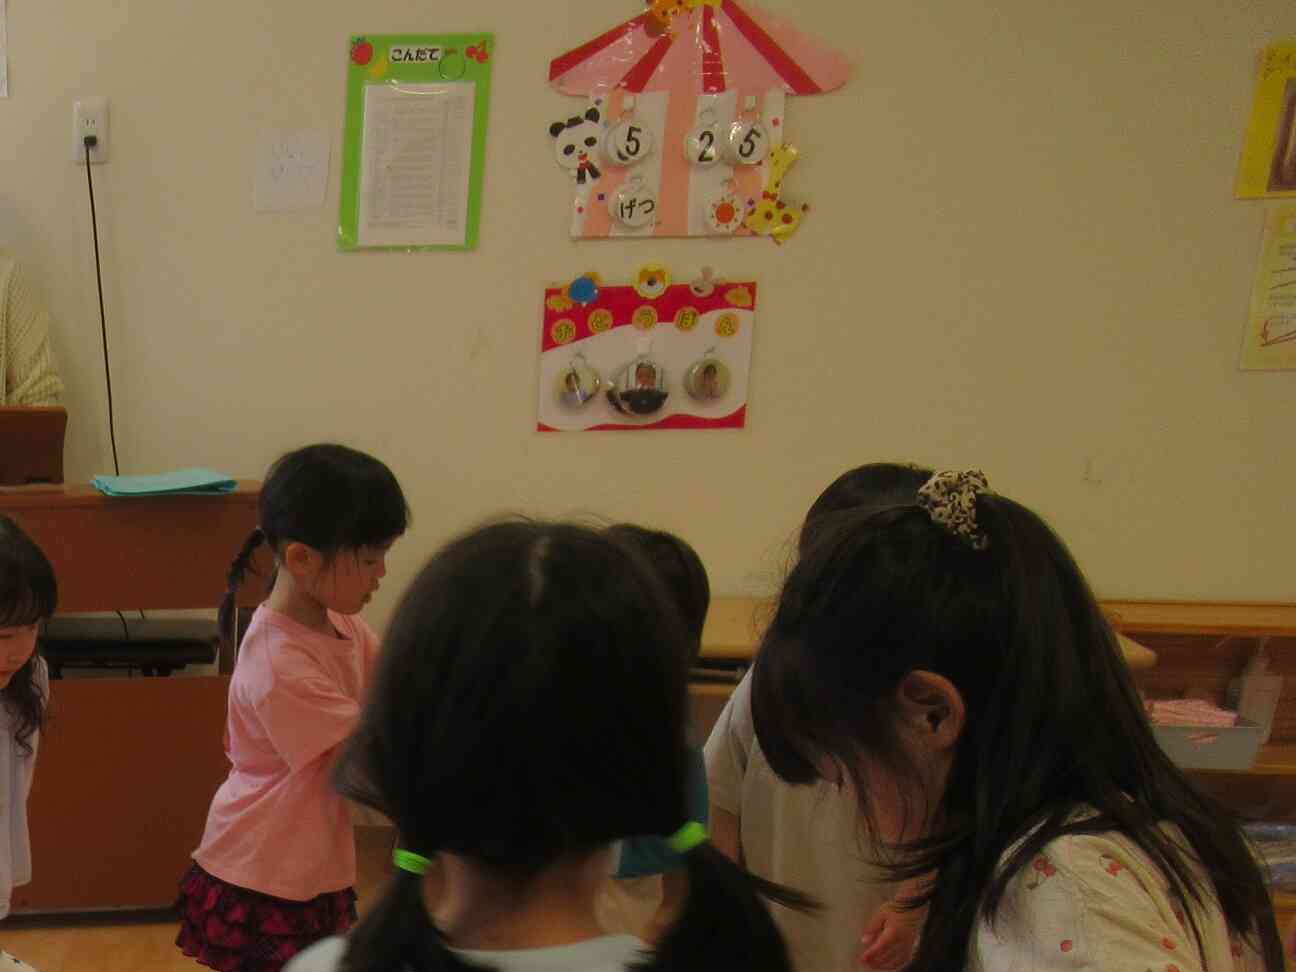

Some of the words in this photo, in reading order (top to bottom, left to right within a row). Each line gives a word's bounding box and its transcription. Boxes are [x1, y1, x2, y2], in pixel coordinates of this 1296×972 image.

[391, 48, 440, 62] こんだて
[625, 126, 642, 157] 5
[620, 198, 655, 219] げつ
